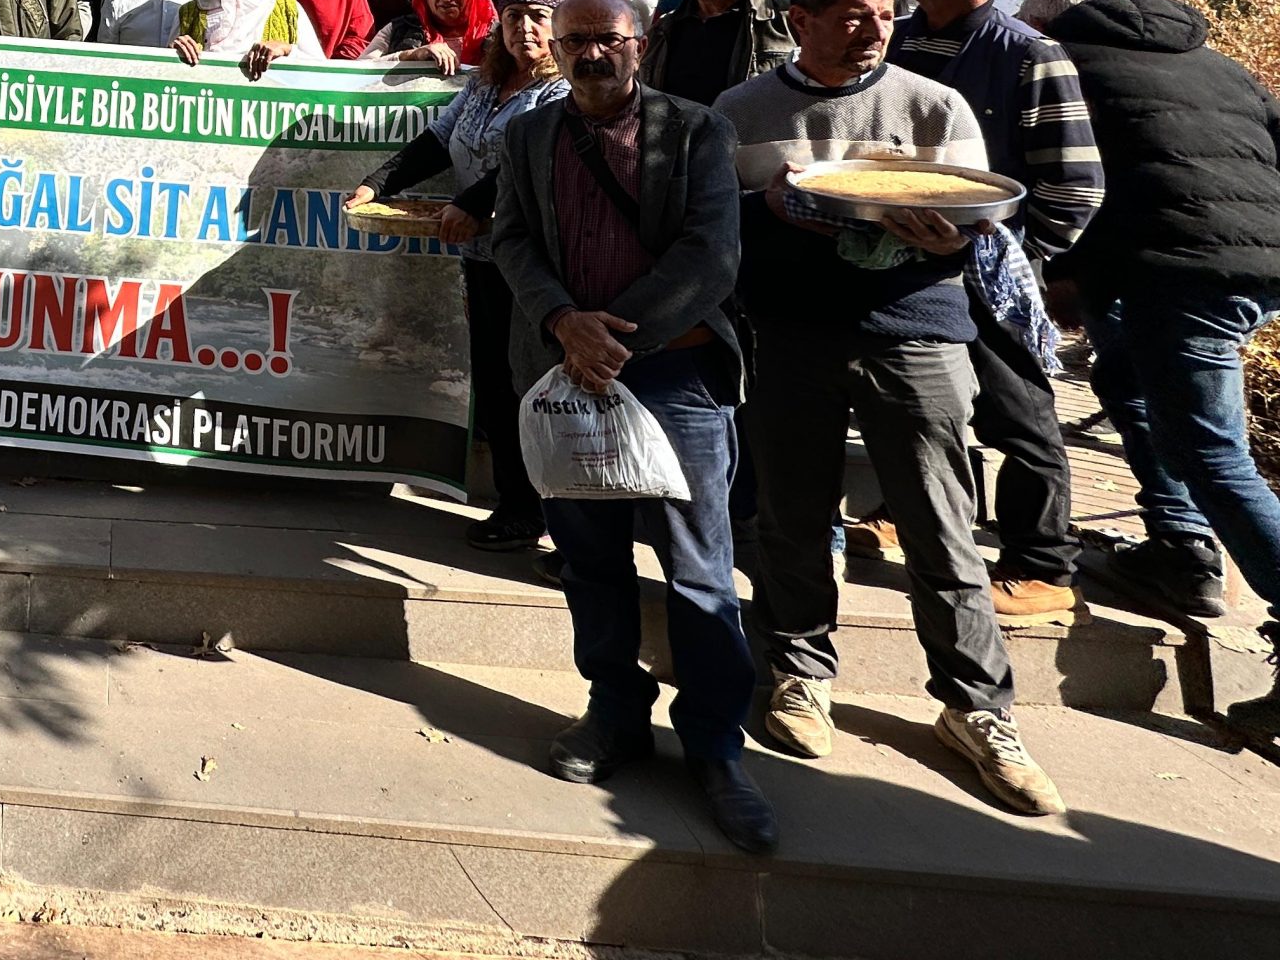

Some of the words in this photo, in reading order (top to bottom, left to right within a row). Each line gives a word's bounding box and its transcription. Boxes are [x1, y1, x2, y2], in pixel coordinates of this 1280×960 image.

[91, 80, 136, 129] BİR
[140, 86, 234, 137] BÜTÜN
[105, 166, 190, 238] SİT
[0, 390, 181, 446] DEMOKRASİ
[192, 408, 387, 464] PLATFORMU
